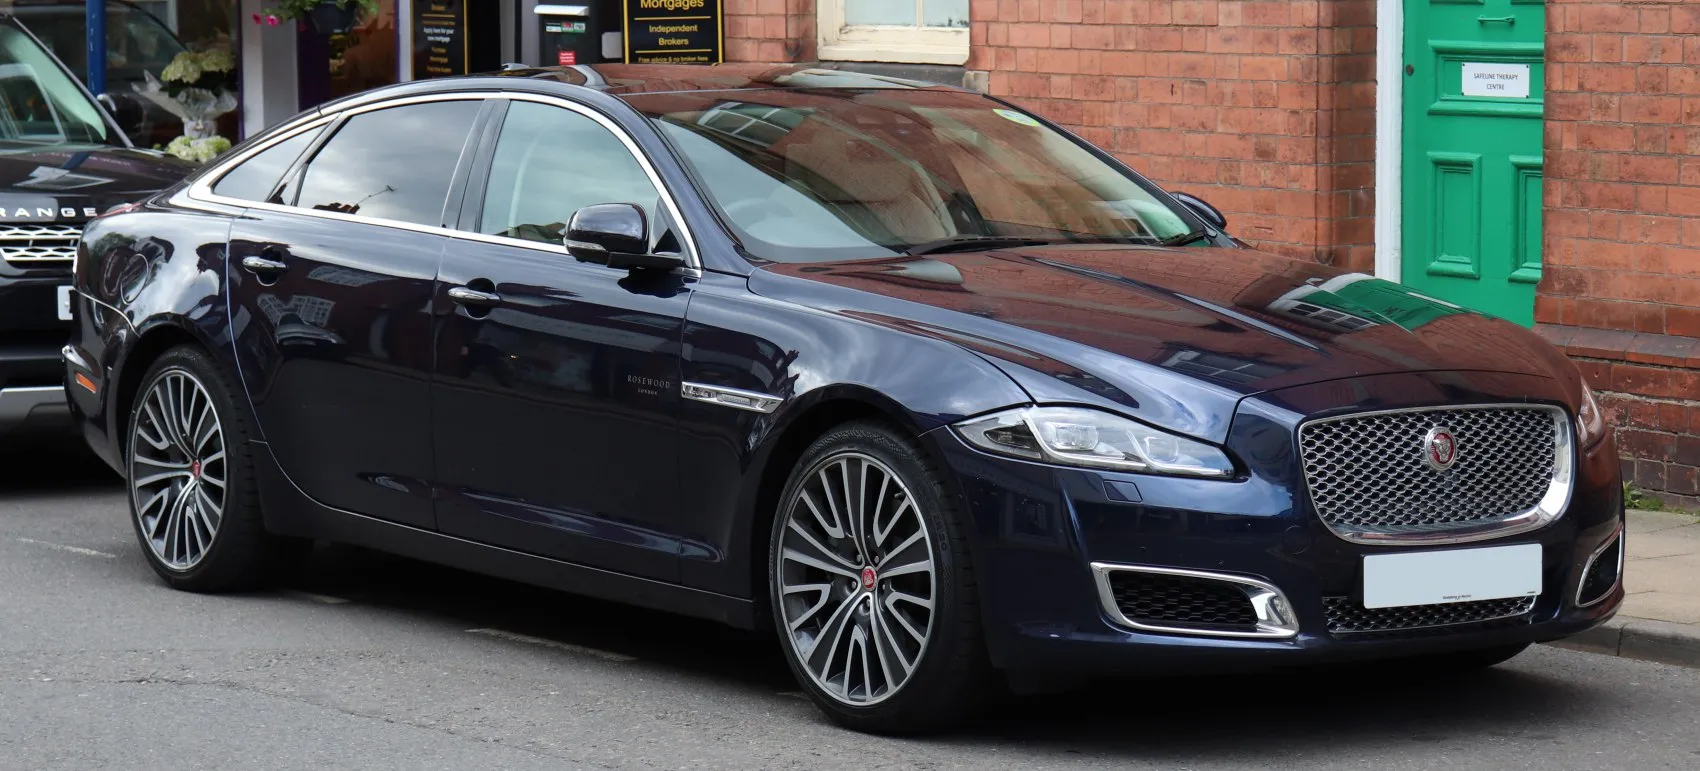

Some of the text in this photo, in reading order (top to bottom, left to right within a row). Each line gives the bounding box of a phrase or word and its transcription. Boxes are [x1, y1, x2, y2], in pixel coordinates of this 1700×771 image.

[640, 0, 704, 10] Mortgages
[649, 25, 698, 34] Independent
[627, 375, 670, 388] ROSEWOOD
